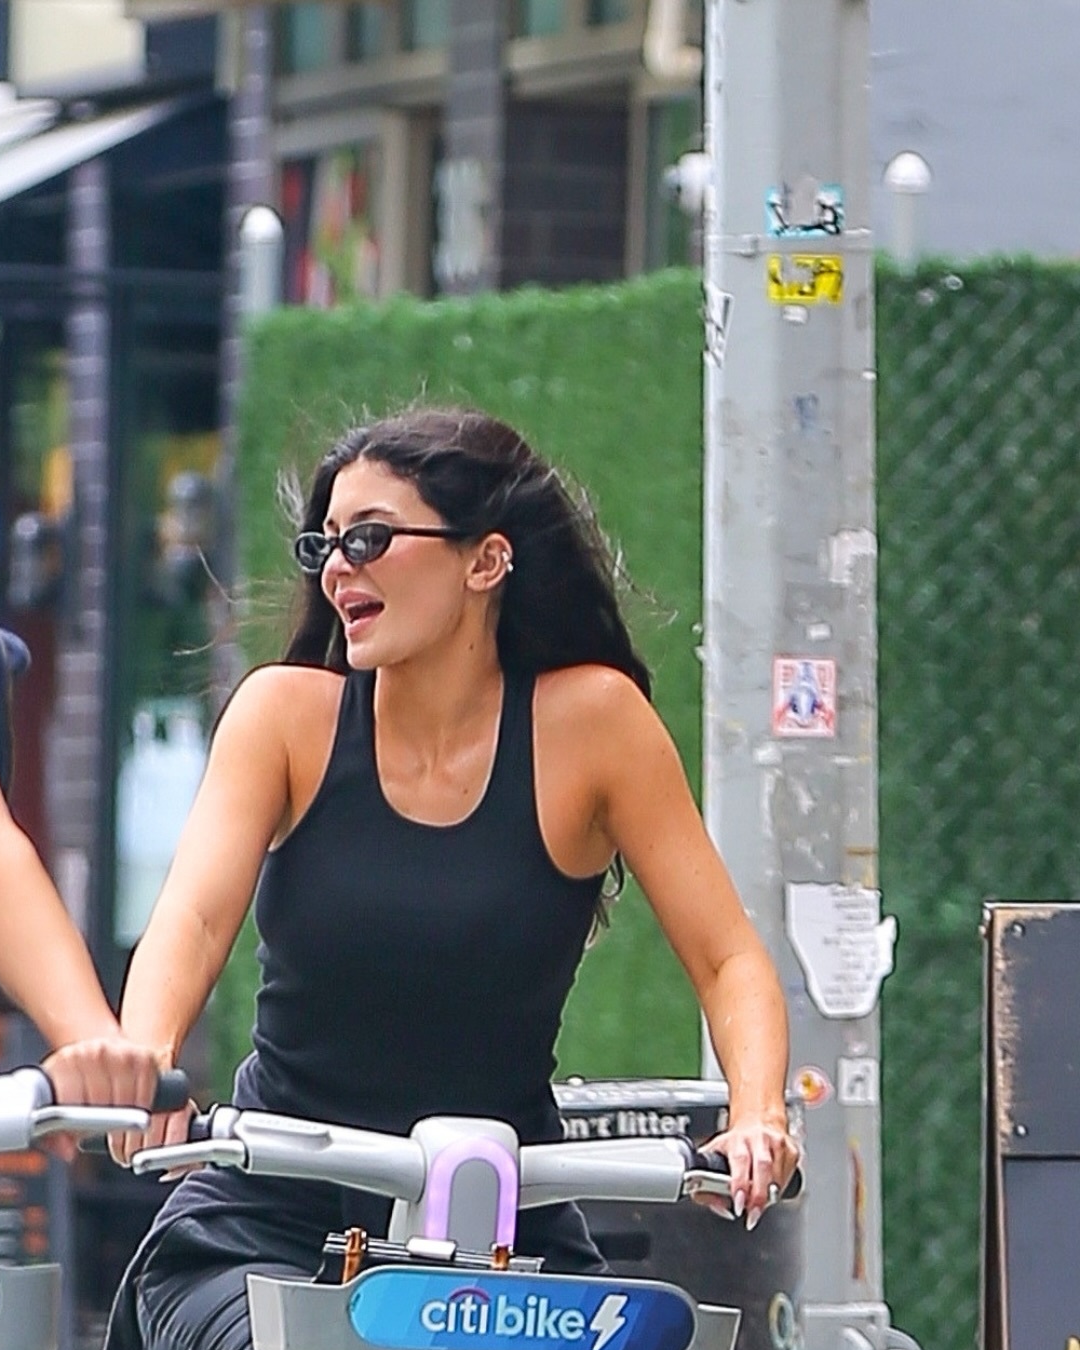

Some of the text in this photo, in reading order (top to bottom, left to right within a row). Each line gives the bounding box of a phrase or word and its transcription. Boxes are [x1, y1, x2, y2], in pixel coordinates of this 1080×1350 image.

[616, 1110, 691, 1136] litter
[420, 1287, 586, 1340] citi bike
